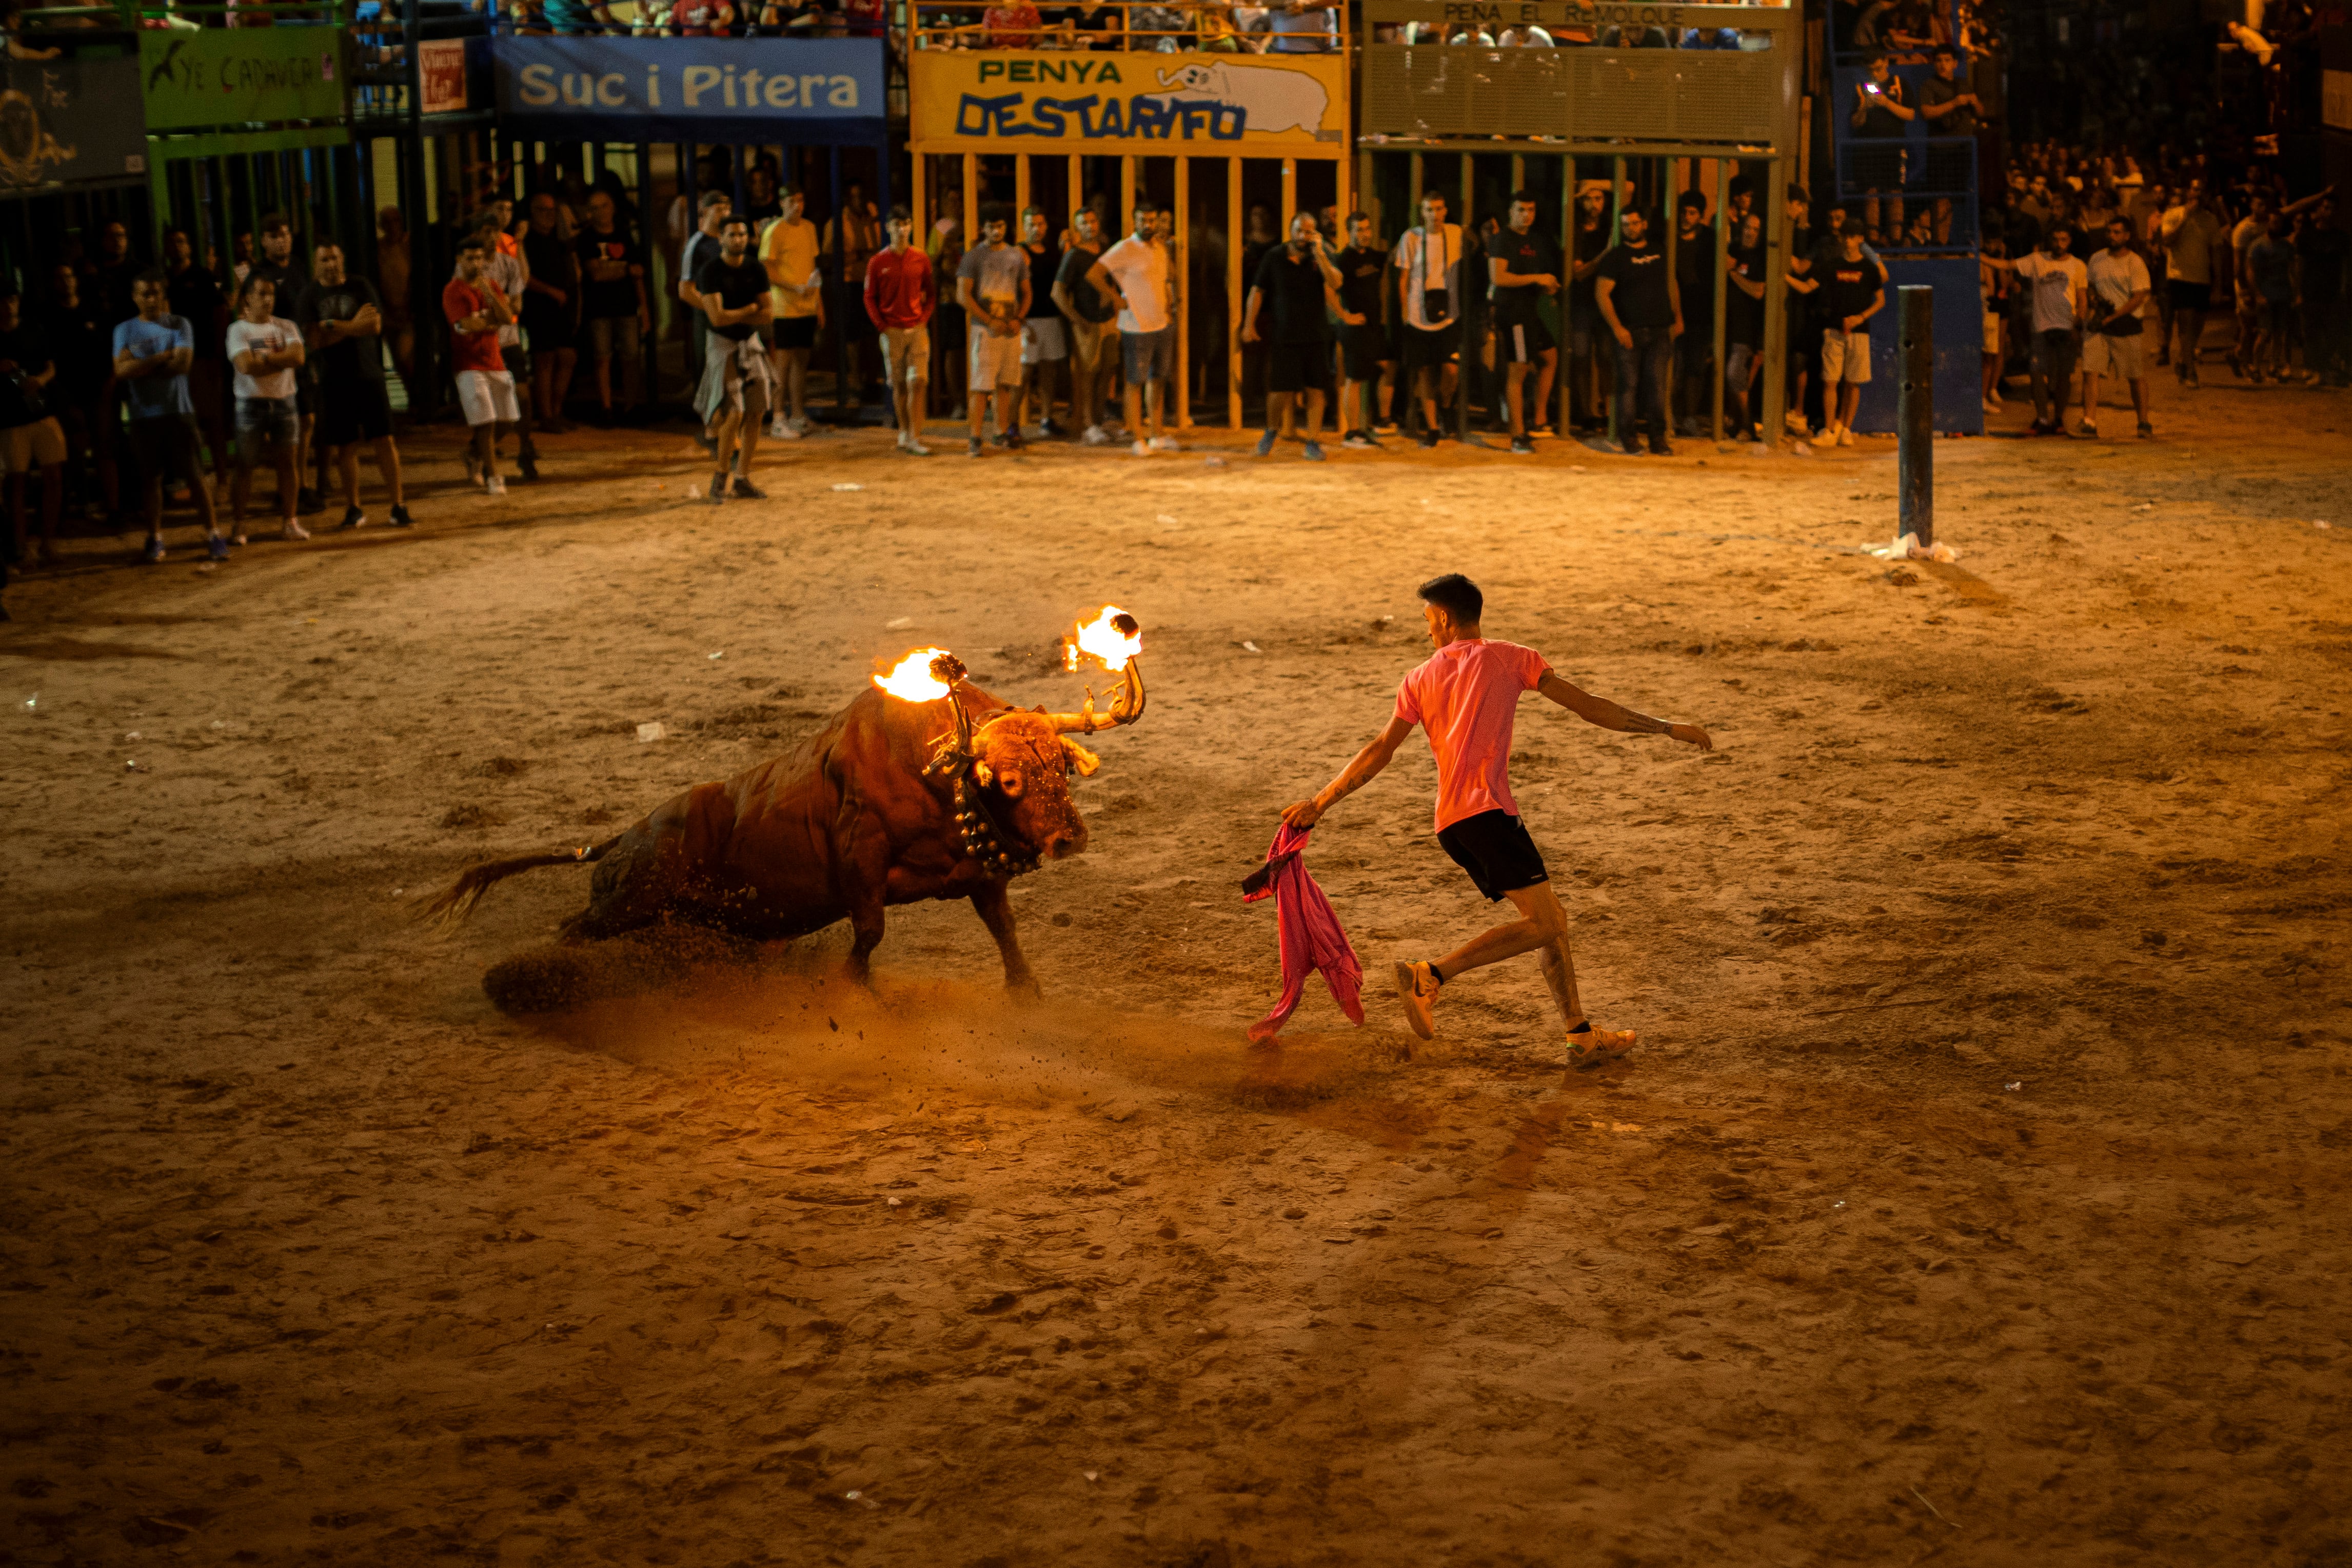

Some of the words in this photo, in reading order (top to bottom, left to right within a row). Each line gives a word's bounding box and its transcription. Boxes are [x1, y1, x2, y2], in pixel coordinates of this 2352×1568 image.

[1520, 5, 1545, 23] EL
[979, 61, 1122, 83] PENYA
[519, 63, 626, 105] Suc
[646, 65, 661, 107] i
[683, 65, 858, 108] Pitera
